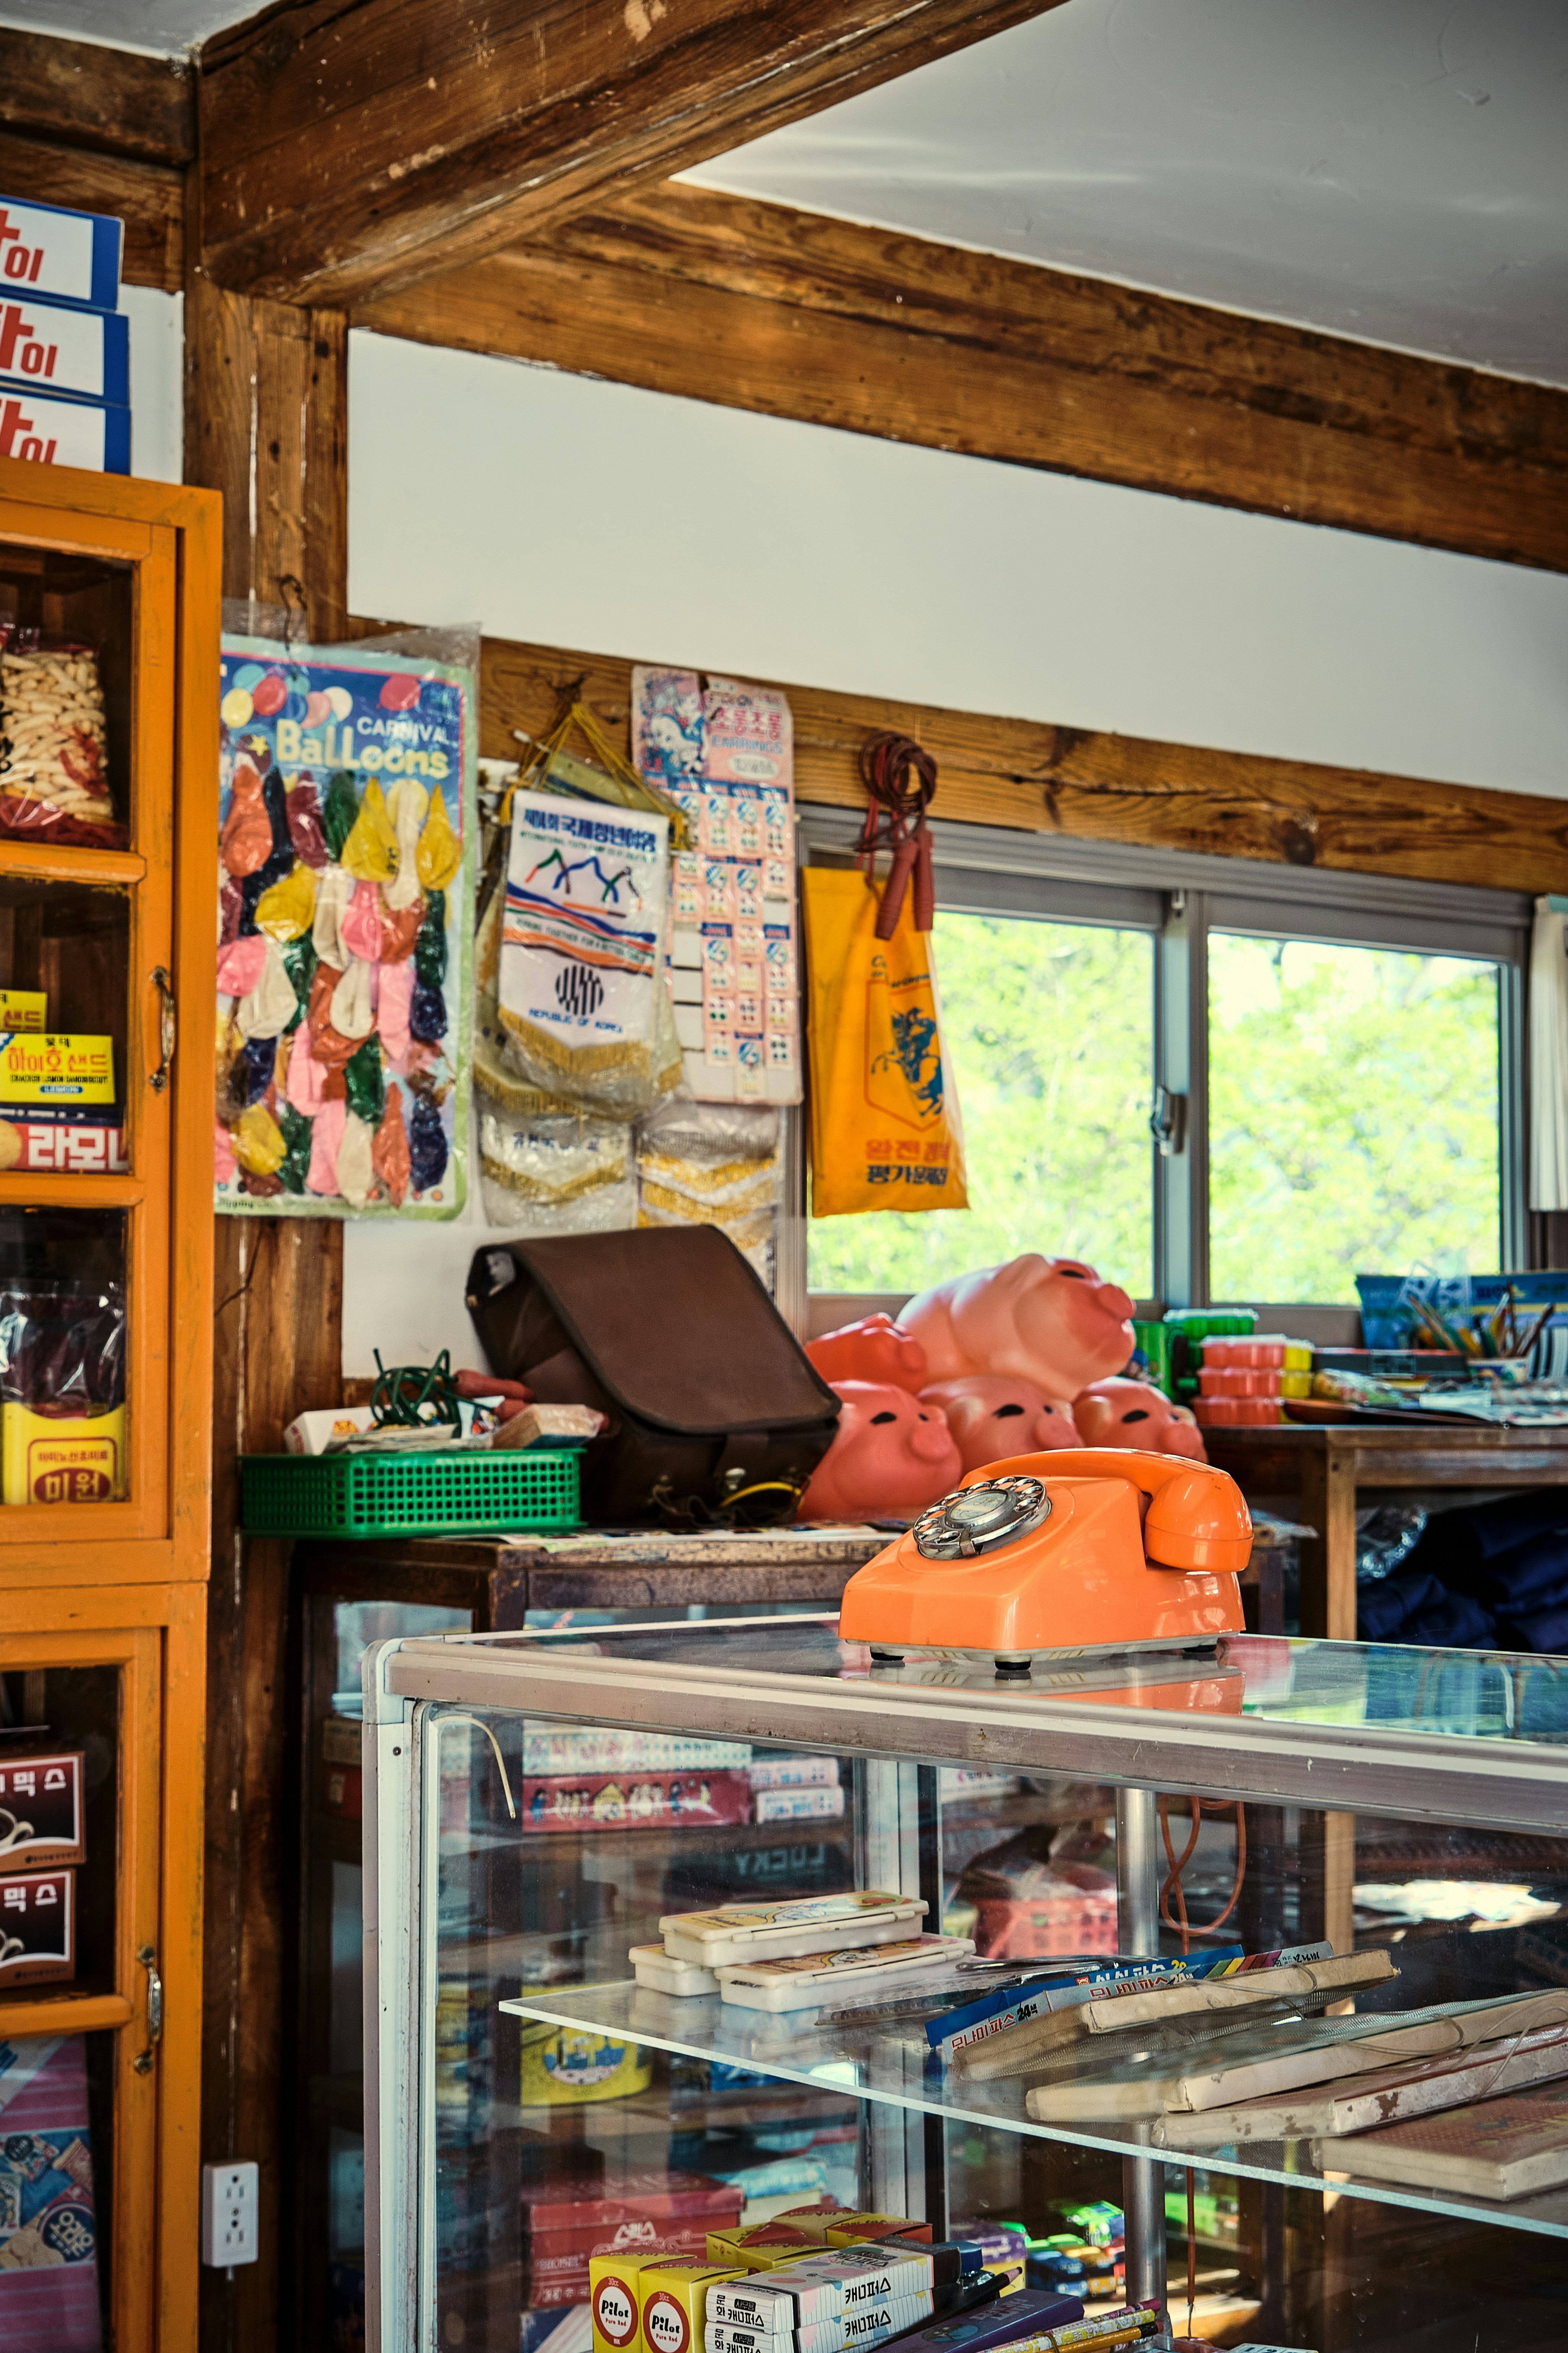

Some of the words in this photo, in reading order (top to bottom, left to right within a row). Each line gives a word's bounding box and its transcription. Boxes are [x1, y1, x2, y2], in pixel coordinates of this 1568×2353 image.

[356, 716, 449, 744] CARNIVAL
[712, 735, 783, 755] EARRINGS
[530, 1007, 572, 1026] REPUBLIC
[577, 1018, 589, 1026] OF
[45, 1472, 99, 1501] 미원
[951, 2013, 1016, 2051] 모나미파스
[608, 2277, 619, 2287] 30cc
[845, 2277, 891, 2304] 캠퍼스
[659, 2292, 669, 2302] 30cc
[735, 2299, 755, 2311] 사무용
[601, 2299, 629, 2318] Pilot
[727, 2309, 764, 2327] 캠퍼스
[651, 2315, 680, 2334] Pilot
[845, 2310, 891, 2337] 캠퍼스
[734, 2334, 753, 2345] 사무용
